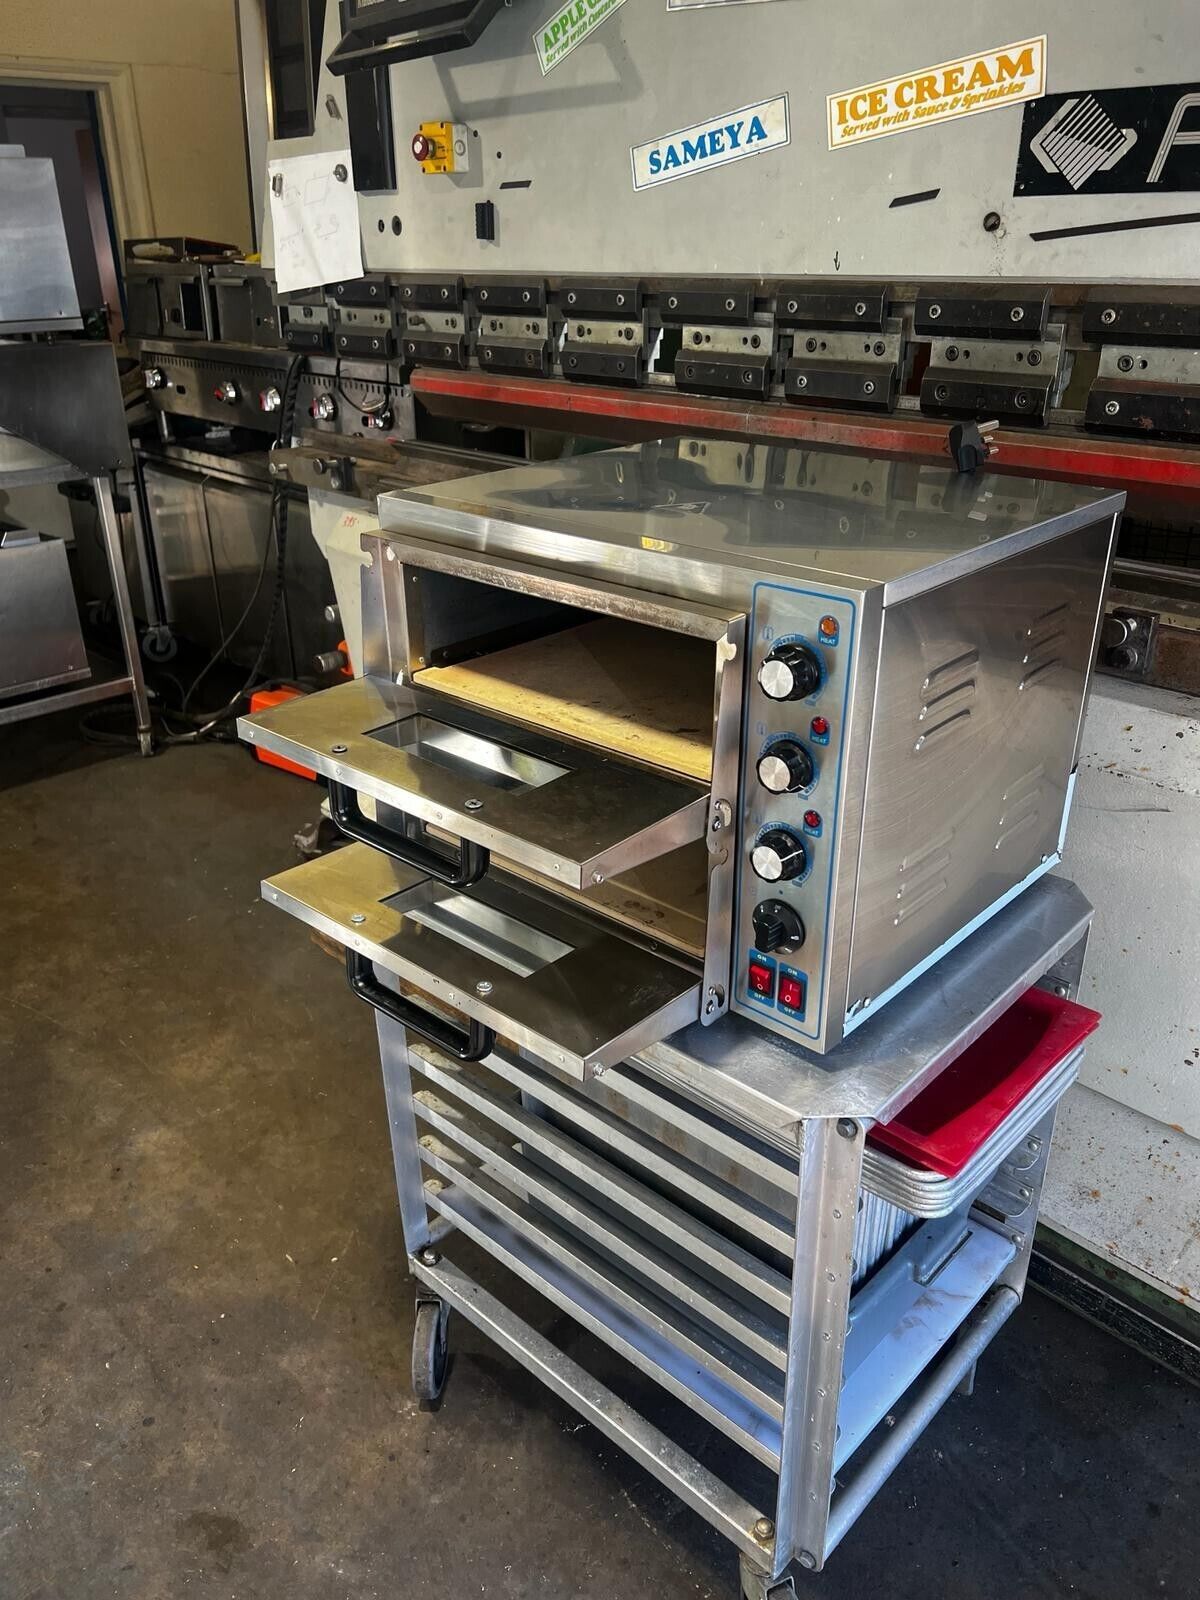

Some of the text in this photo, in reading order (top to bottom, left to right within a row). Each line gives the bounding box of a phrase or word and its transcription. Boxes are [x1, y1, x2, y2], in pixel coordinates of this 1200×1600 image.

[543, 0, 587, 53] APPLE
[545, 35, 570, 66] Served
[837, 48, 1035, 125] ICE CREAM
[840, 81, 1026, 138] Served with Sauce & Sprinkles
[648, 115, 768, 175] SAMEYA
[757, 954, 766, 962] ON
[787, 968, 797, 976] ON
[784, 1006, 795, 1014] OFF
